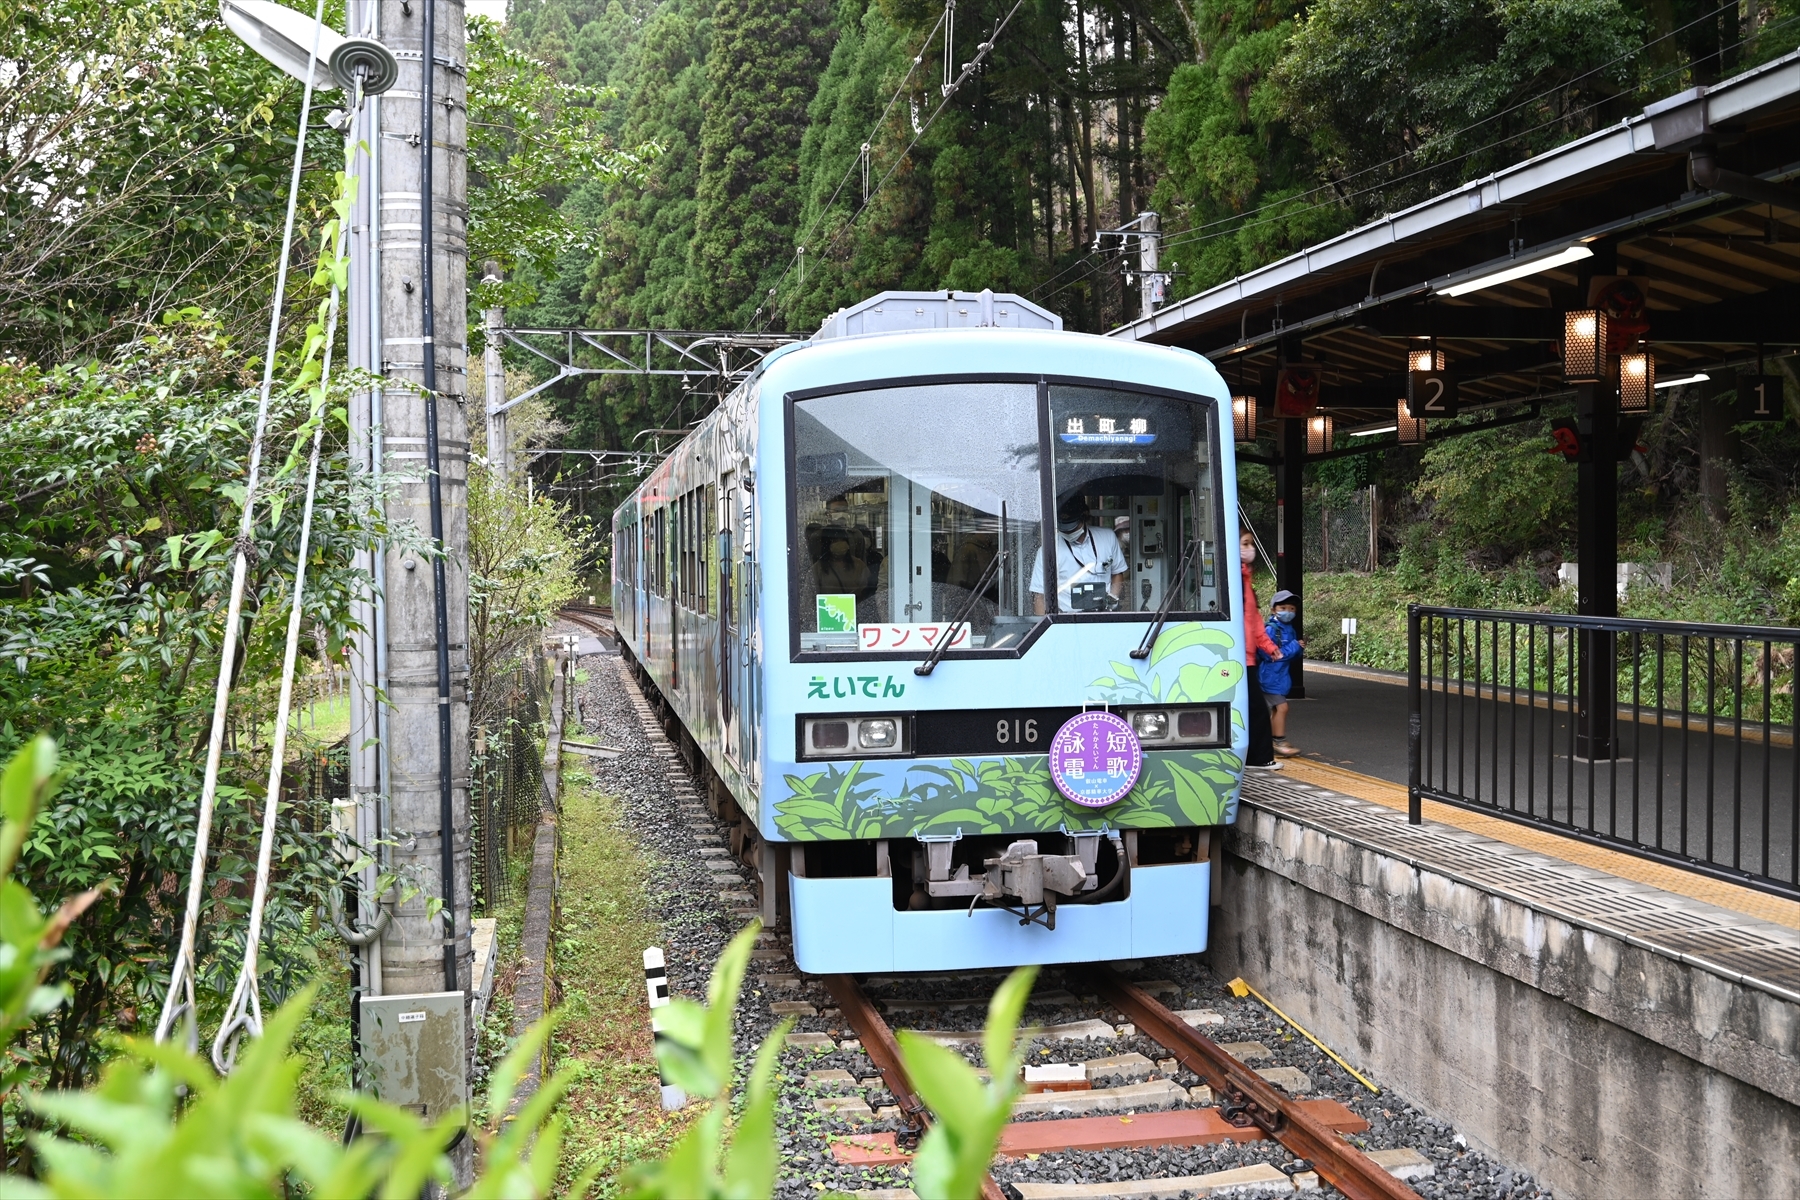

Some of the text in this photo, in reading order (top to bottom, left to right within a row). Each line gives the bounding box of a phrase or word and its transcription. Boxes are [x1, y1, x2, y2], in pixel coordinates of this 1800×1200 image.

[1425, 378, 1445, 410] 2
[1754, 383, 1770, 414] 1
[1067, 418, 1147, 433] 出町柳
[1078, 434, 1136, 442] Demachiyanagi
[862, 626, 967, 648] ワンマン
[807, 675, 905, 699] えいでん
[996, 719, 1039, 744] 816
